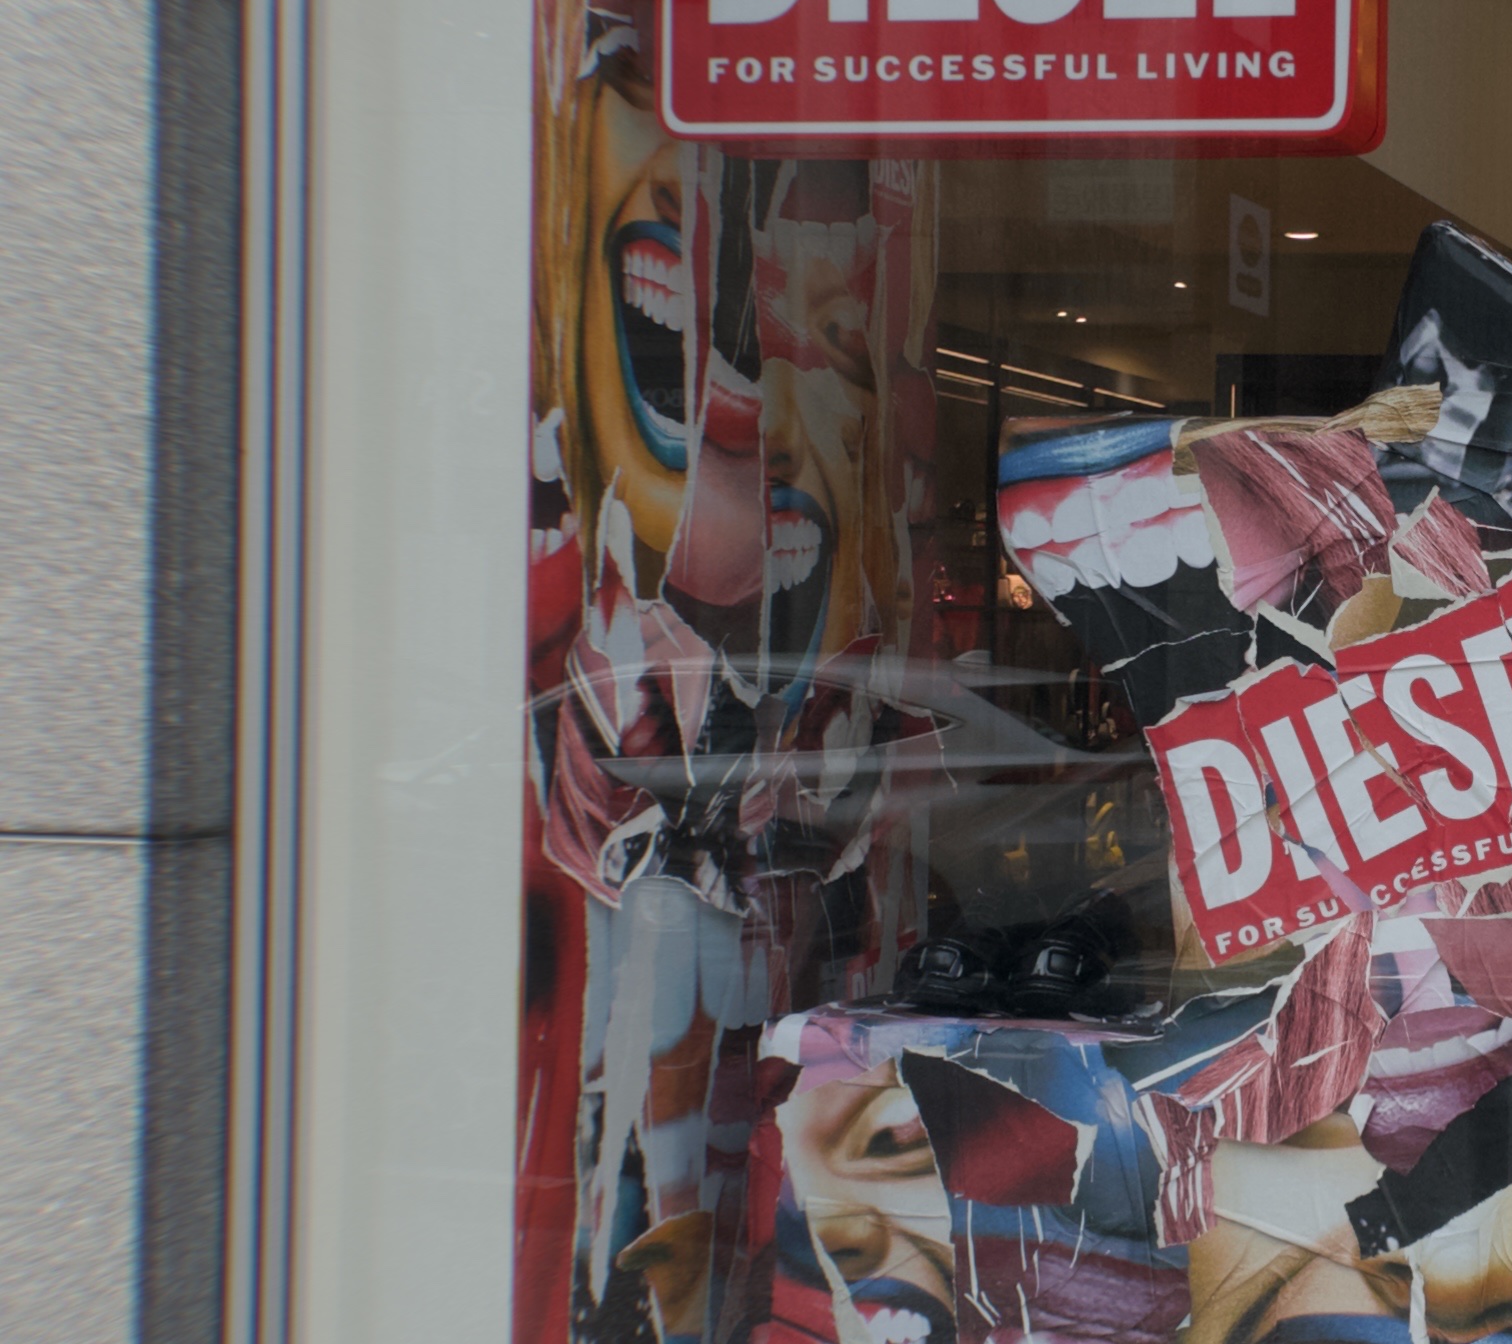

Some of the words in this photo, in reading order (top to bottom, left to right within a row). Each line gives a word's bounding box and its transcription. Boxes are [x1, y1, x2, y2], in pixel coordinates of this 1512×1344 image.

[708, 56, 796, 85] FOR
[813, 51, 1118, 83] SUCCESSFUL
[1137, 49, 1297, 80] LIVING
[1215, 917, 1284, 955] FOR
